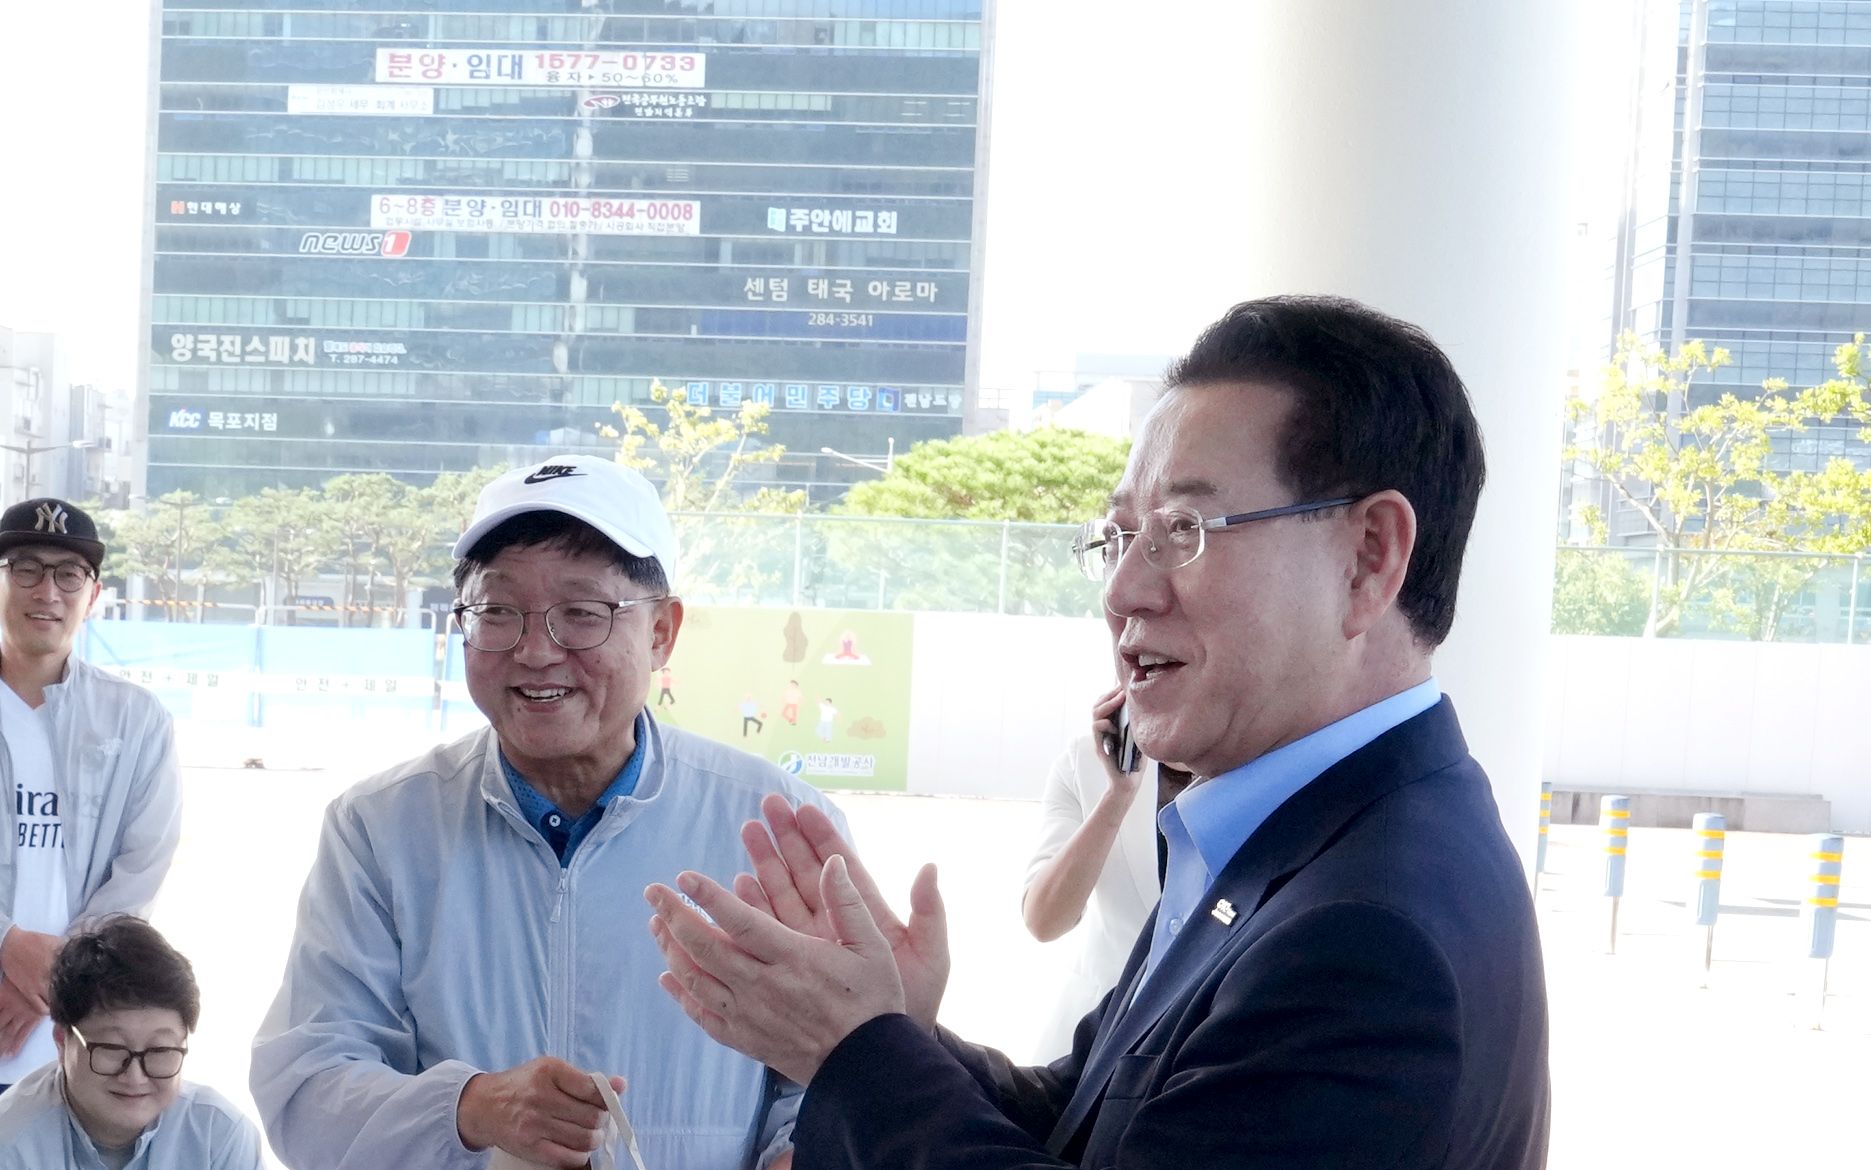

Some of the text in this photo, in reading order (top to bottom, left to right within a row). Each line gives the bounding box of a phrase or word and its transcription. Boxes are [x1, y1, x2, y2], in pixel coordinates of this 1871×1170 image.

[534, 53, 696, 72] 1577-0733
[186, 201, 242, 215] 현대해상
[549, 200, 694, 221] 010-8344-0008
[789, 207, 898, 234] 주안에교회
[743, 277, 939, 303] 센텀 태국 아로마
[808, 312, 874, 327] 284-3541
[170, 333, 316, 365] 양국진스피치
[686, 381, 873, 411] 더불어민주당
[169, 407, 278, 432] KCC 목포지점
[535, 464, 578, 477] NIKE
[34, 502, 69, 534] NY
[15, 783, 59, 817] ira
[17, 822, 65, 849] BETT
